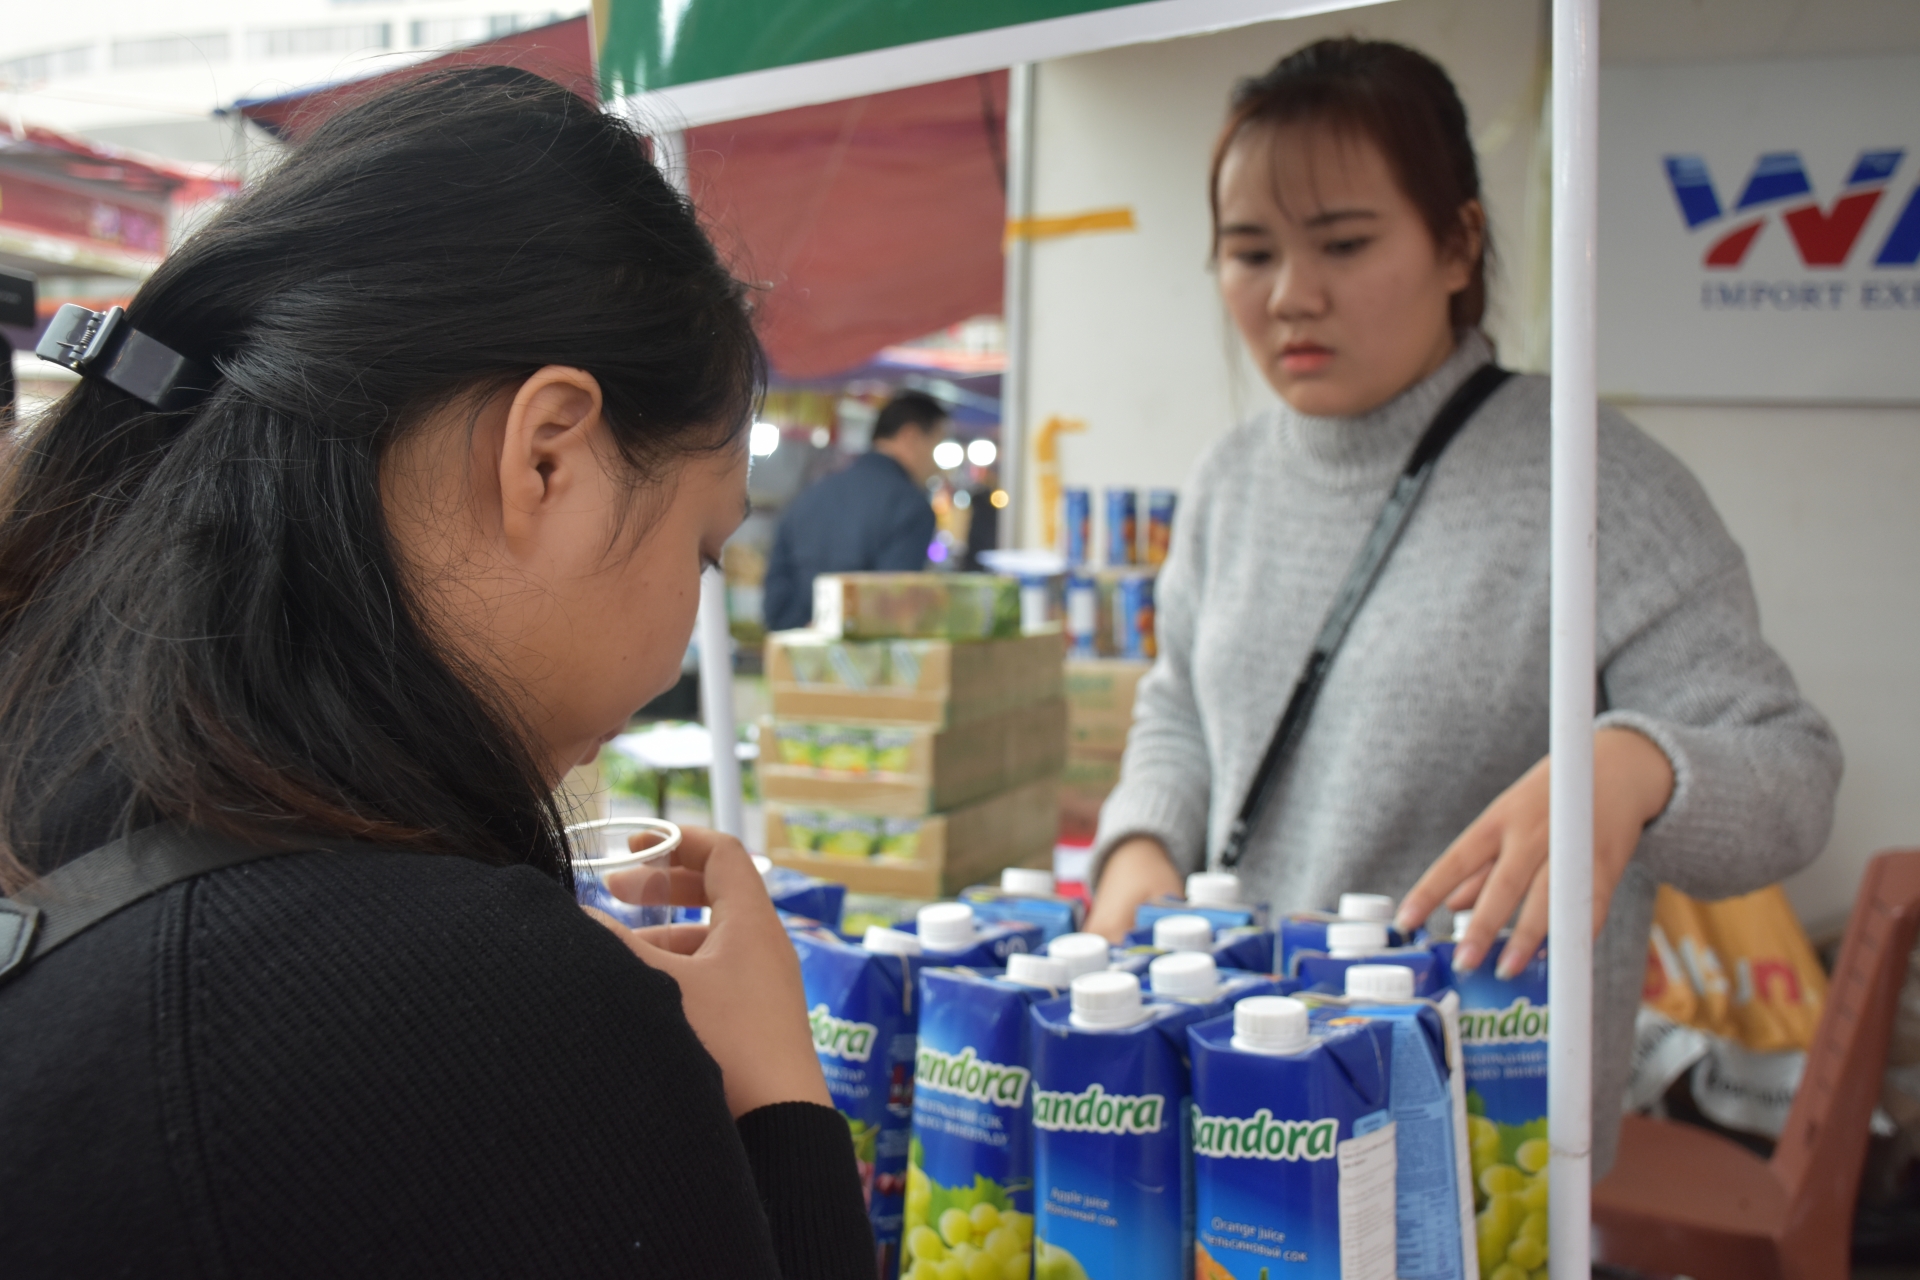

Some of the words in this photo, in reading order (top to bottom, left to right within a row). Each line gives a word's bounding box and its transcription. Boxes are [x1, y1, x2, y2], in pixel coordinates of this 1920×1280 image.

[1701, 280, 1847, 311] IMPORT
[1050, 1187, 1082, 1204] Apple
[1083, 1192, 1110, 1210] juice
[1211, 1217, 1257, 1239] Orange
[1258, 1225, 1286, 1243] juice
[1283, 1250, 1308, 1262] сок
